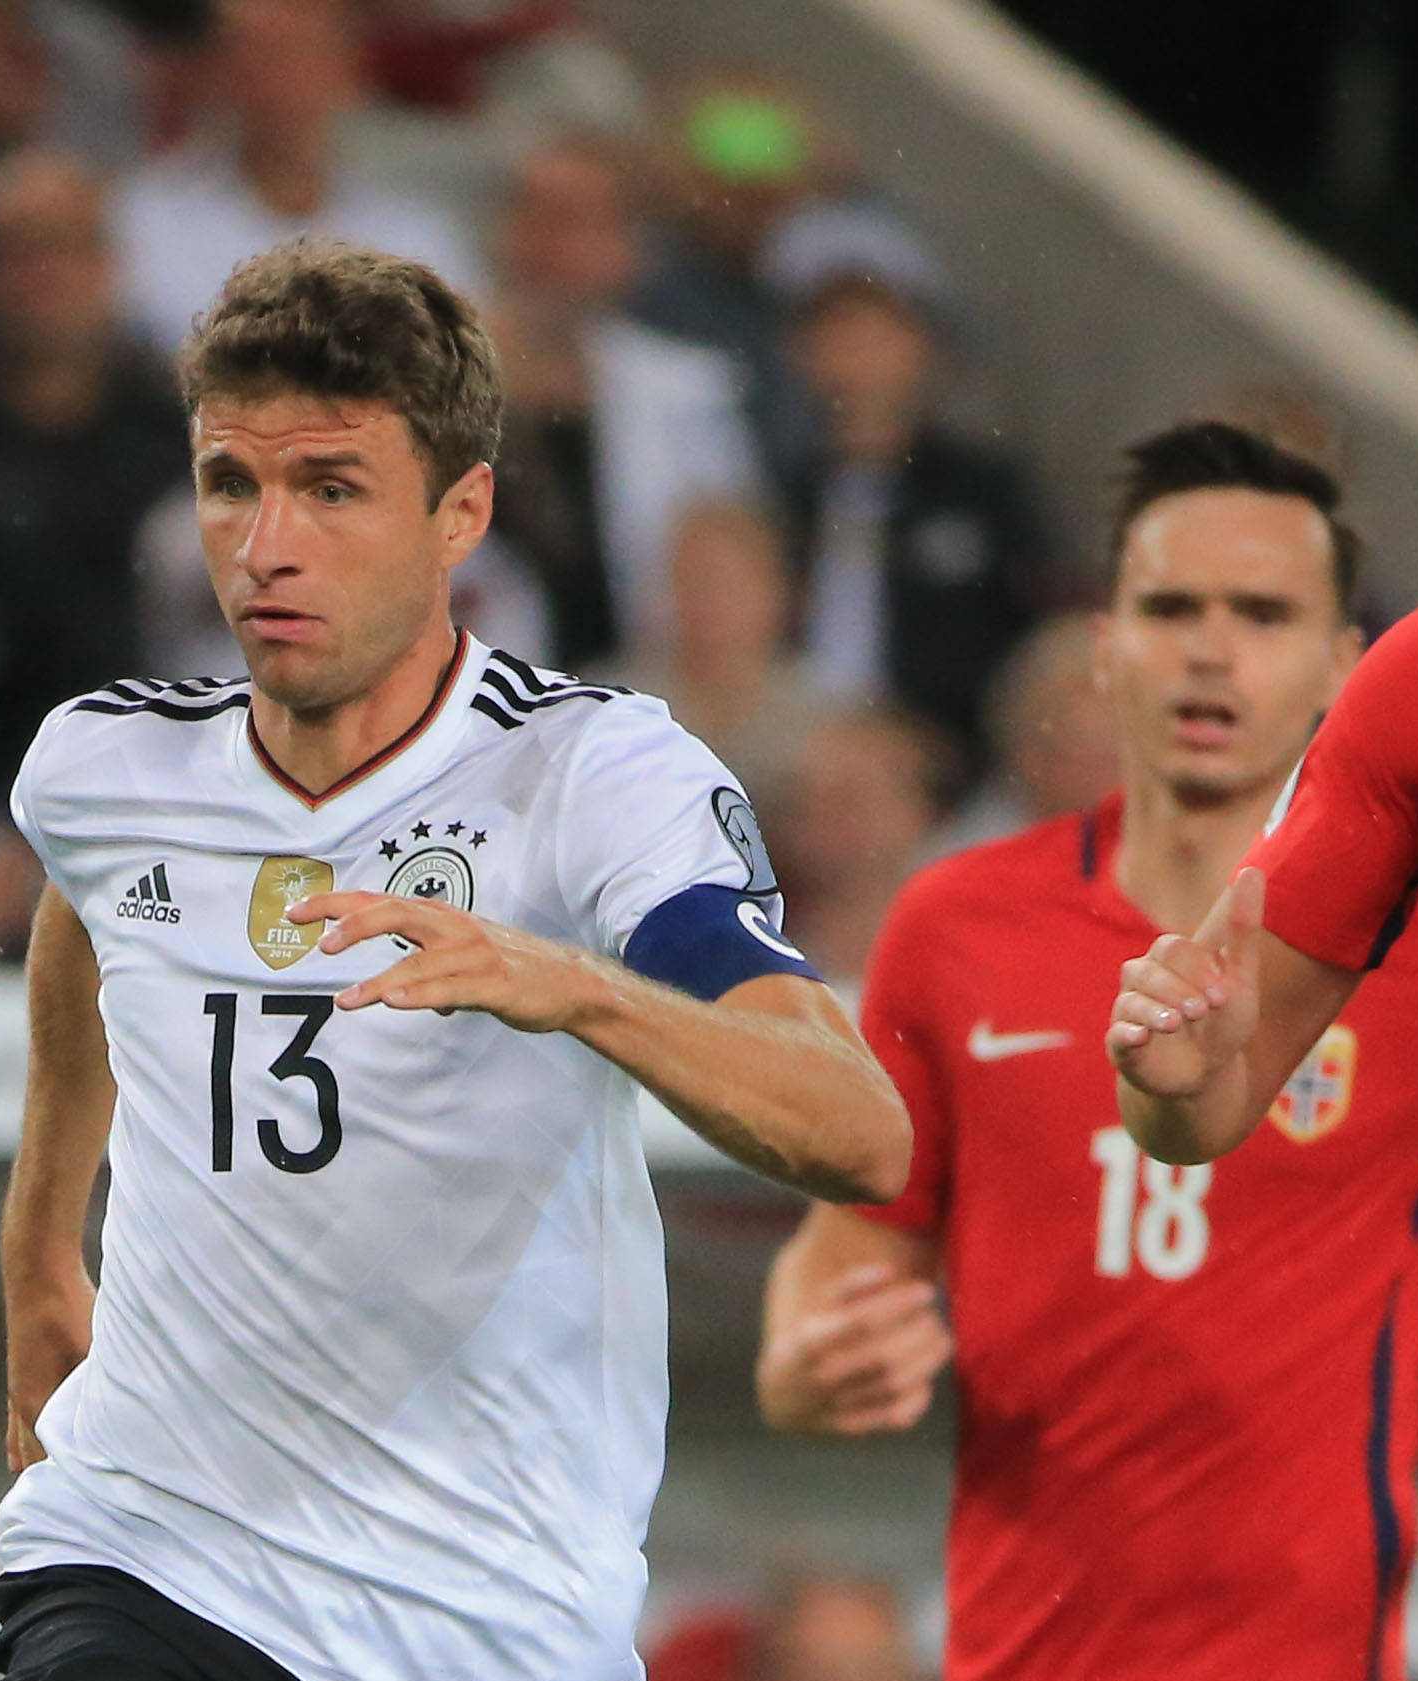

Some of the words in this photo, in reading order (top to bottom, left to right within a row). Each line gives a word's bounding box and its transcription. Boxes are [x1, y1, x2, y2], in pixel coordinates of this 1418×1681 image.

[404, 860, 458, 883] DEUTSCHER
[116, 899, 182, 925] adidas
[267, 928, 302, 944] FIFA
[204, 993, 343, 1174] 13
[1091, 1124, 1211, 1280] 18
